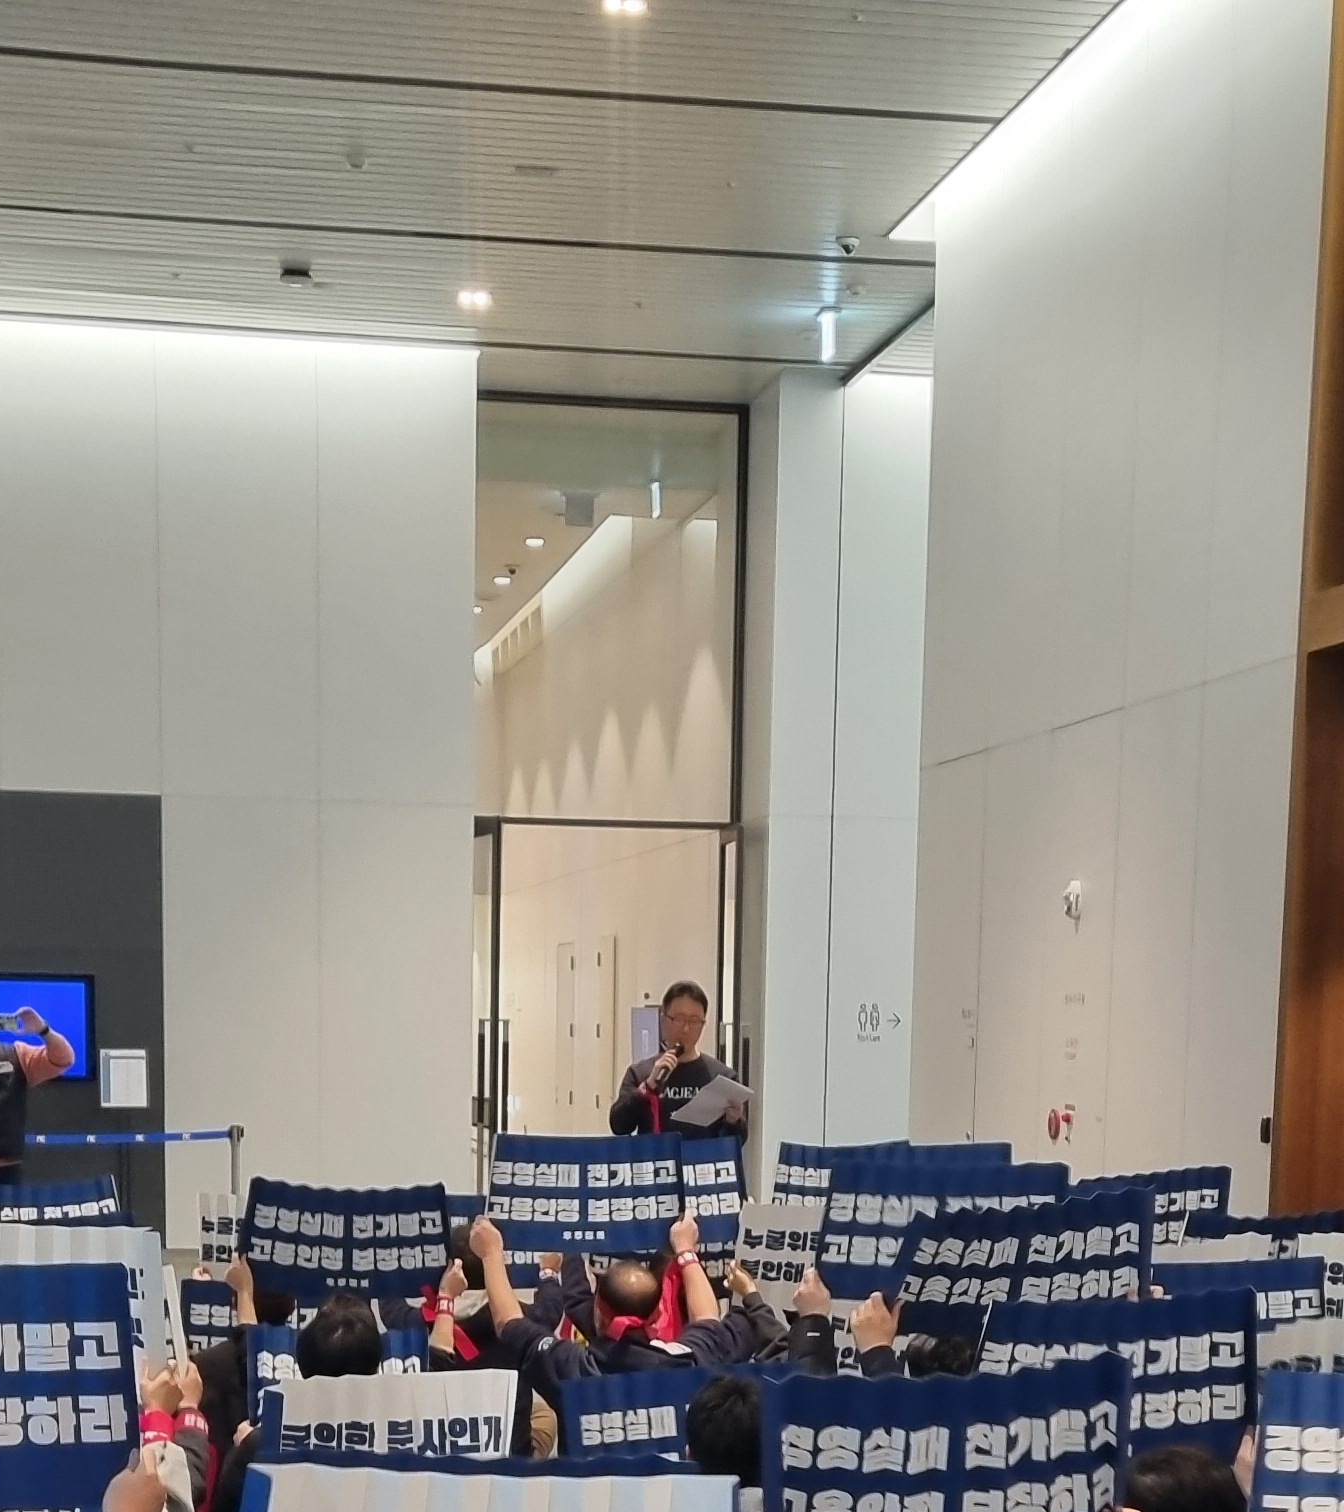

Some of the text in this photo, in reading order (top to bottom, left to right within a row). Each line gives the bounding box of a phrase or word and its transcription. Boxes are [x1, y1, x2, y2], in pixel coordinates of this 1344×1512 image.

[492, 1160, 677, 1187] 경영실패 전가말고
[682, 1162, 737, 1186] 말고
[254, 1203, 444, 1239] 경영실패 전가말고
[487, 1196, 579, 1221] 고용안정
[587, 1194, 680, 1221] 보장하라
[248, 1236, 447, 1272] 고용안정 보장하라
[821, 1234, 904, 1266] 고용안
[1027, 1221, 1140, 1264] 전가말고
[1257, 1288, 1323, 1320] 말고
[1130, 1383, 1246, 1430] 장하라
[966, 1400, 1118, 1469] 전가말고
